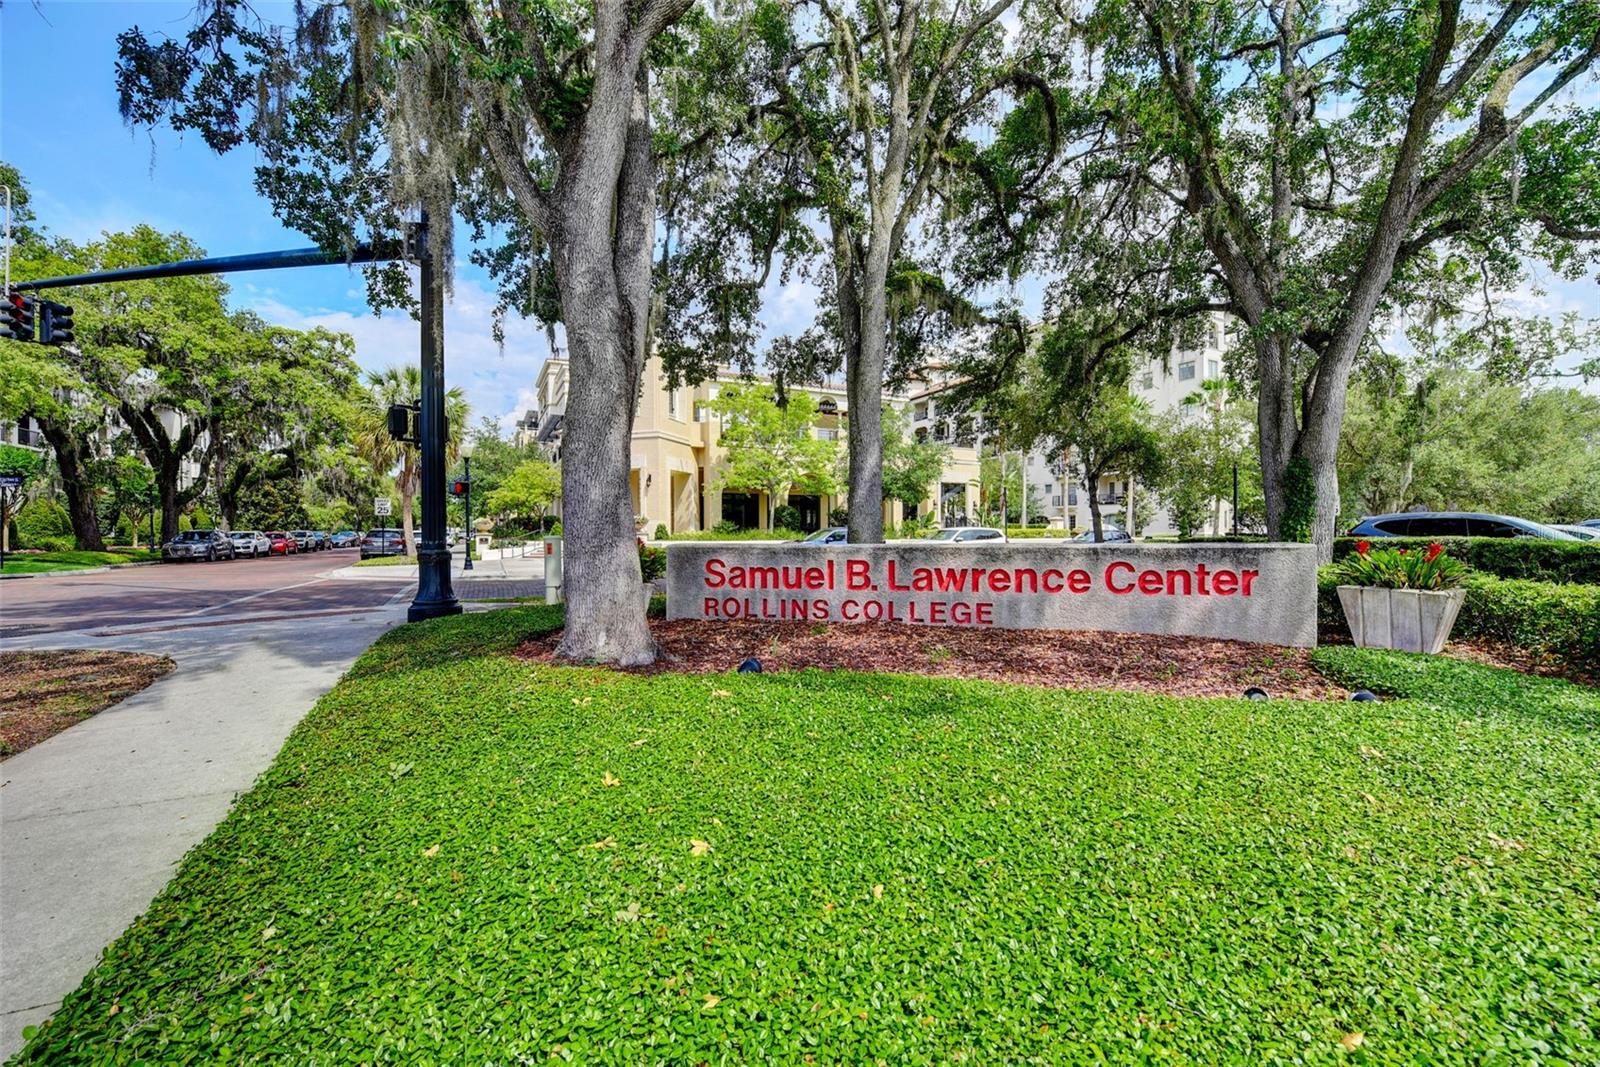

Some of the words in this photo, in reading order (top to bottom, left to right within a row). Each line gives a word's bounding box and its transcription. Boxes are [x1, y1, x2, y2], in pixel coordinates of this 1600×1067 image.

[377, 506, 389, 514] 25
[704, 559, 834, 591] Samuel
[846, 560, 878, 591] B.
[887, 560, 1092, 595] Lawrence
[1104, 562, 1259, 597] Center
[704, 597, 829, 619] ROLLINS
[841, 600, 993, 625] COLLEGE
